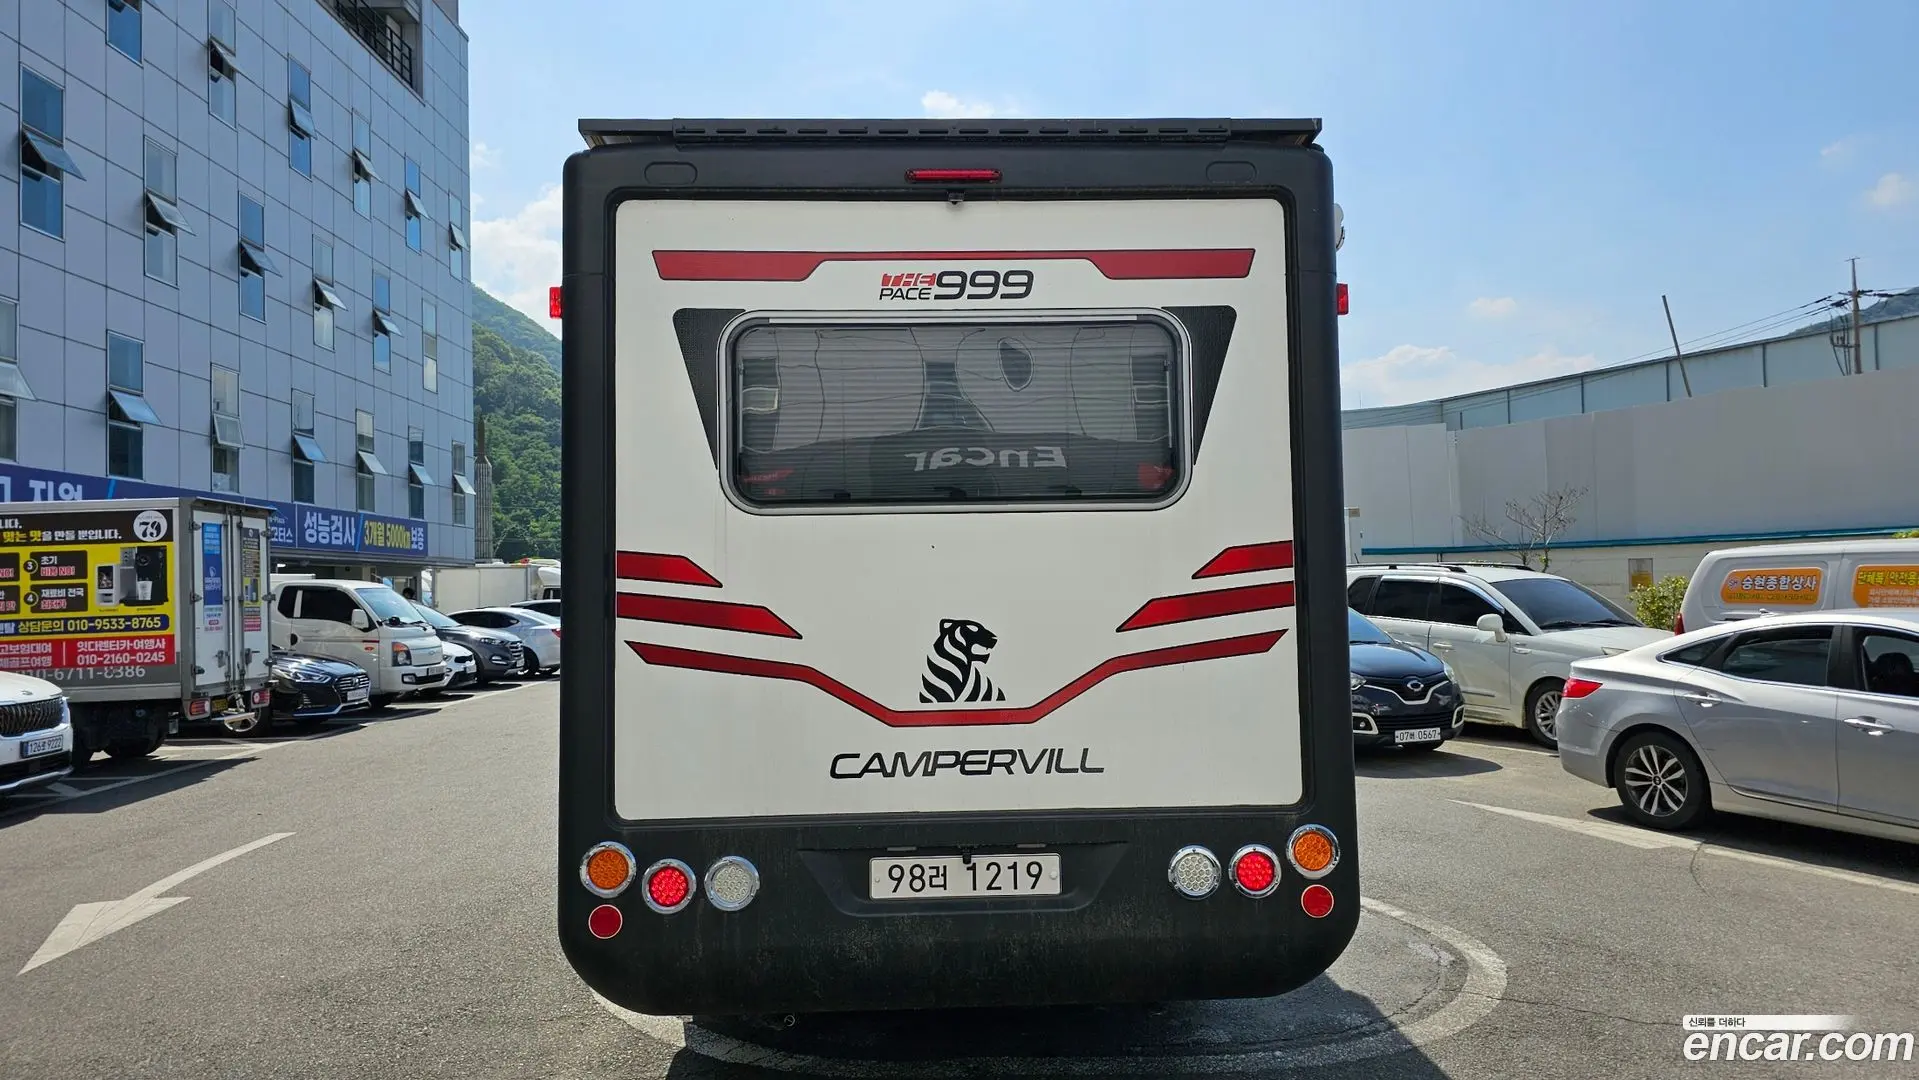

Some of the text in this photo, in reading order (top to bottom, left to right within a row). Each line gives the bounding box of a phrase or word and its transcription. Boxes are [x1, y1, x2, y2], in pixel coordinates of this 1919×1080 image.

[879, 270, 1034, 300] PACE 999
[304, 511, 424, 550] 성능검사 3개월 5000km 보증
[18, 620, 64, 633] 상담문의
[68, 616, 161, 630] 010-9533-8765
[77, 652, 166, 665] 010-2160-0245
[1417, 729, 1437, 740] 0567
[829, 748, 1105, 779] CAMPERVILL
[888, 861, 1043, 893] 98러 1219
